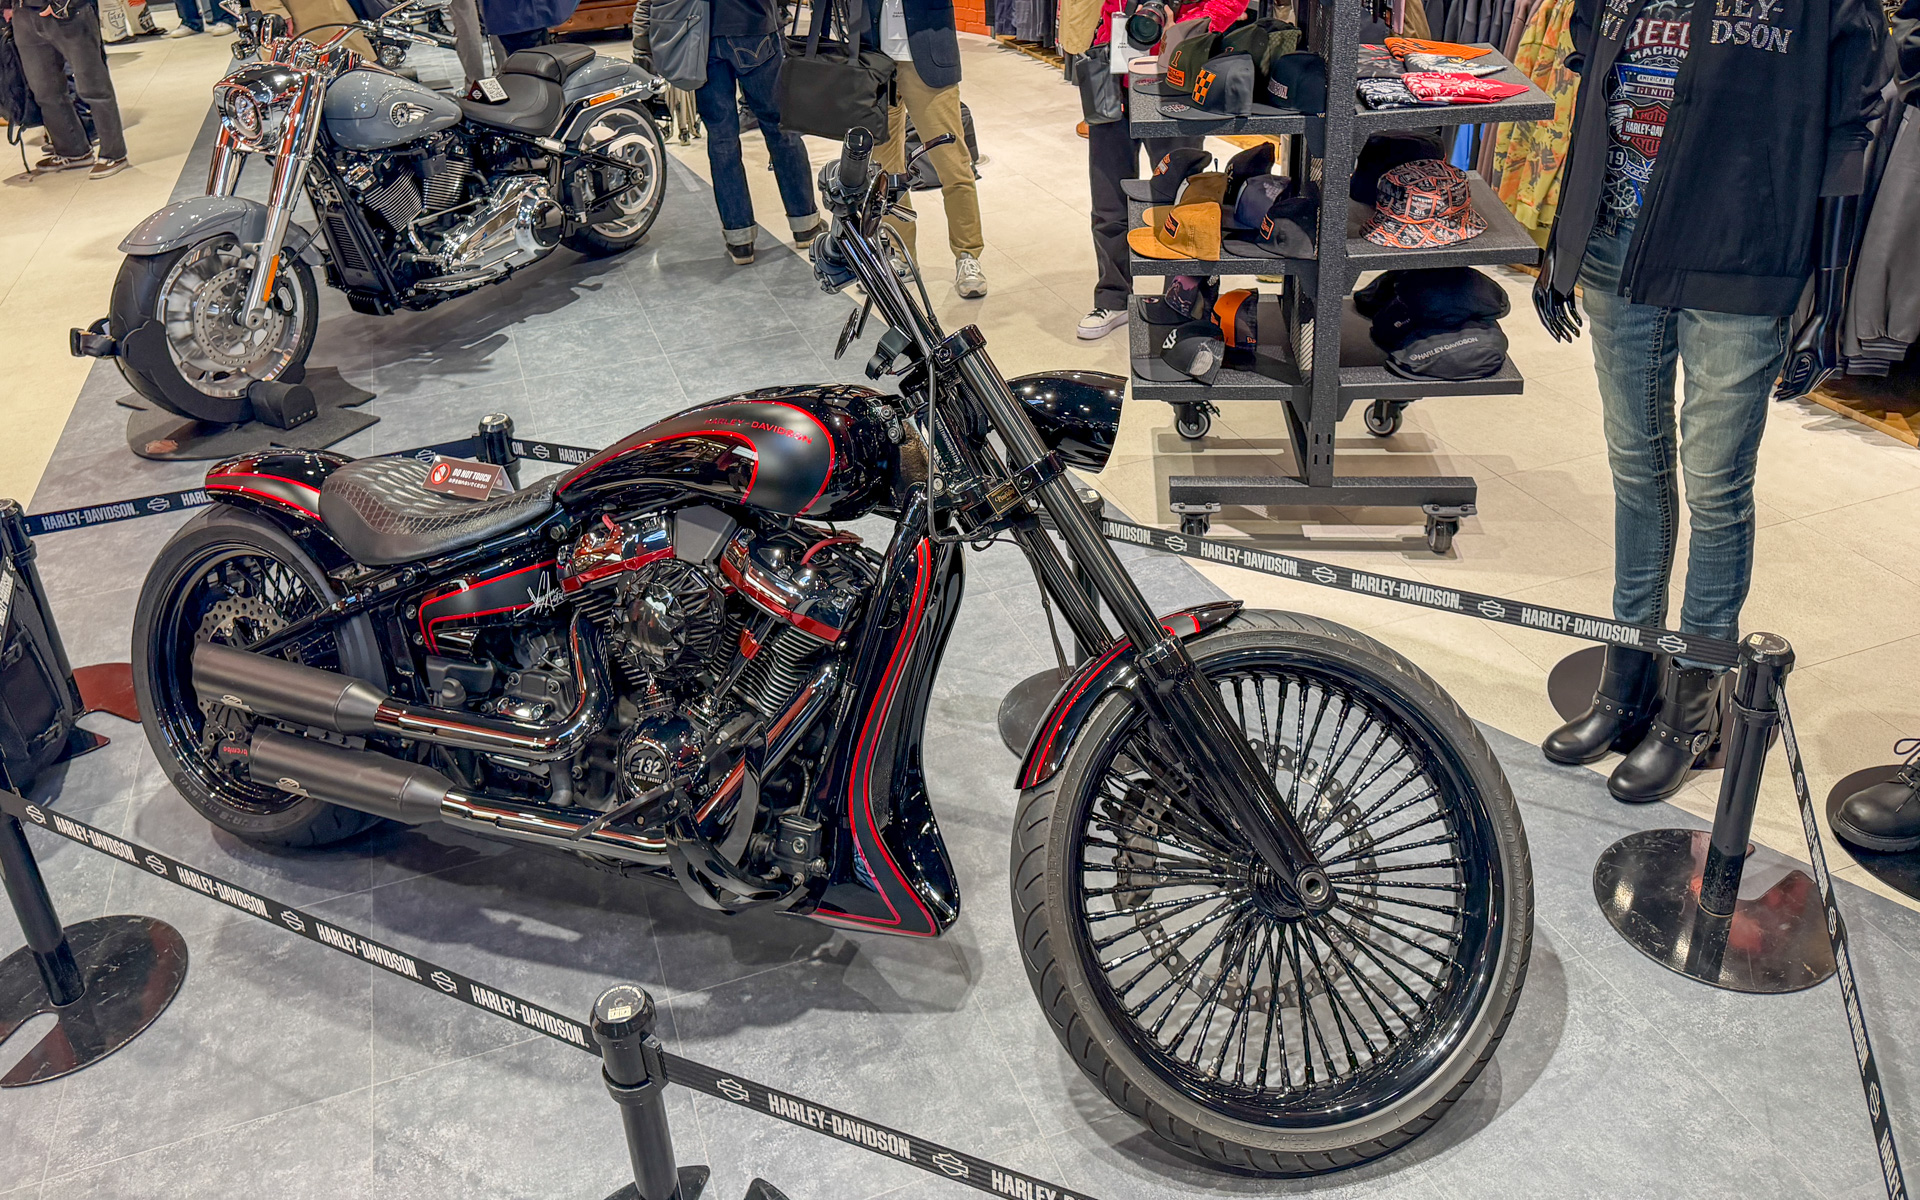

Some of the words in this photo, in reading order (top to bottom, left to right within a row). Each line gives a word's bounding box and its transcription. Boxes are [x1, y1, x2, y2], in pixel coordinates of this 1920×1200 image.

[452, 467, 462, 477] DO
[460, 469, 473, 479] NOT
[637, 757, 661, 775] 132
